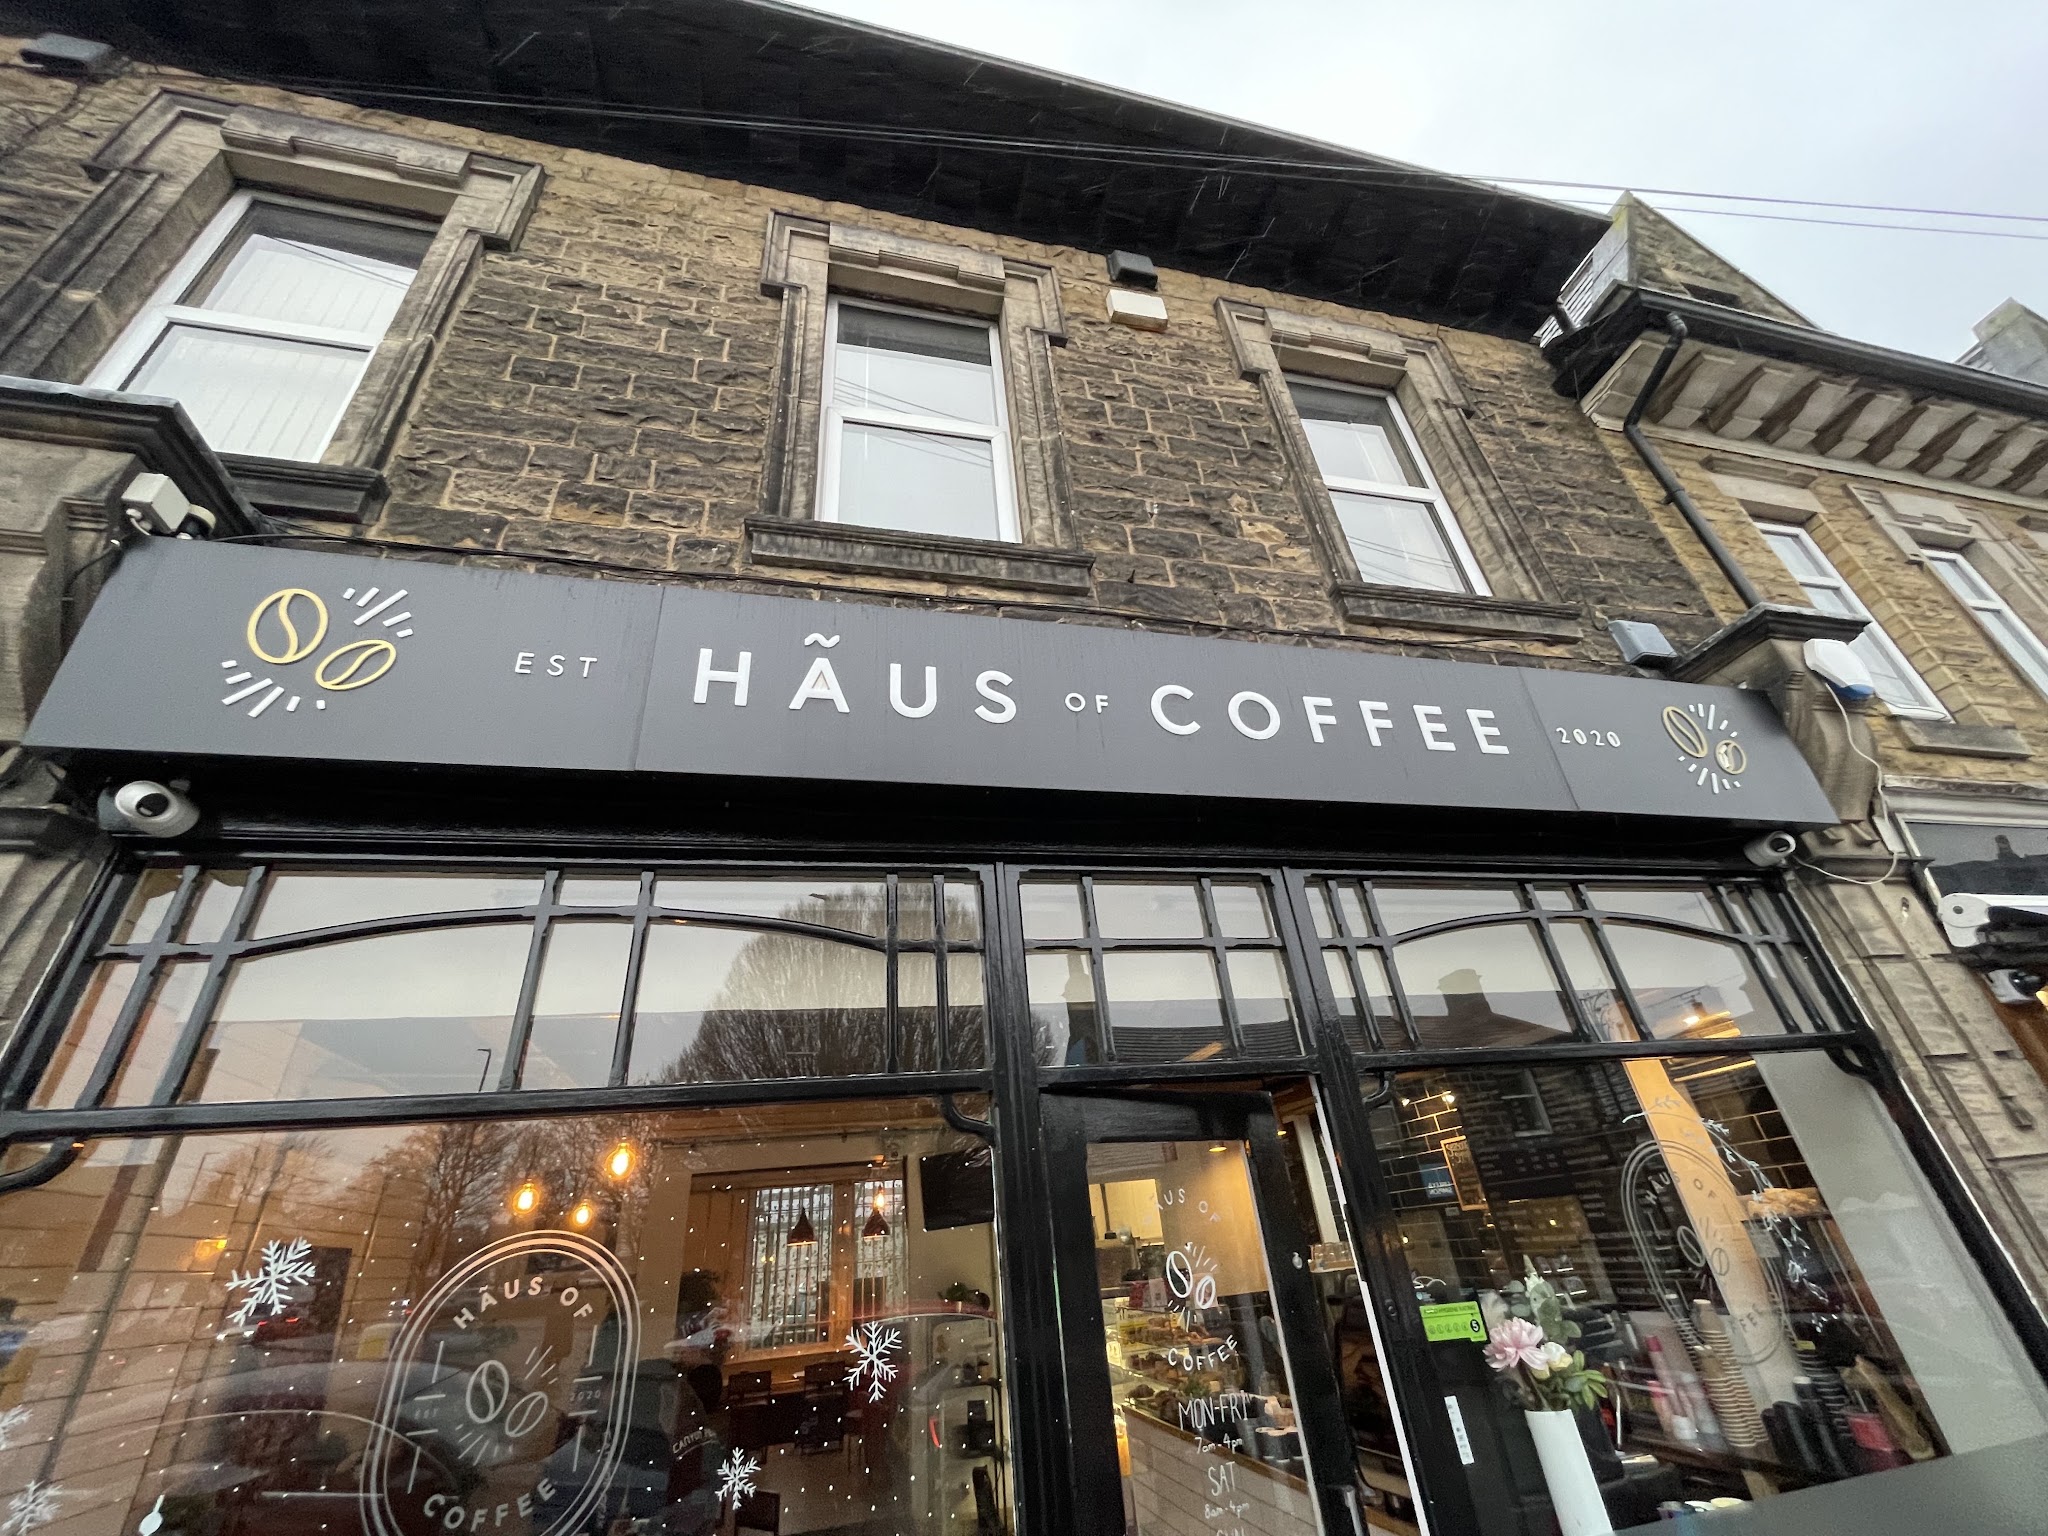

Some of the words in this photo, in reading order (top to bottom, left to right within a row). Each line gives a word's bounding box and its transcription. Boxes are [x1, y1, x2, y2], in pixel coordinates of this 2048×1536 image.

[515, 651, 598, 678] EST
[1064, 692, 1109, 714] OF
[1150, 684, 1510, 755] COFFEE
[1555, 727, 1621, 748] 2020
[560, 1286, 593, 1319] OF
[1471, 1320, 1479, 1332] 5
[1168, 1334, 1238, 1371] COFFEE
[1208, 1461, 1235, 1496] SAT
[423, 1477, 557, 1533] COFFEE
